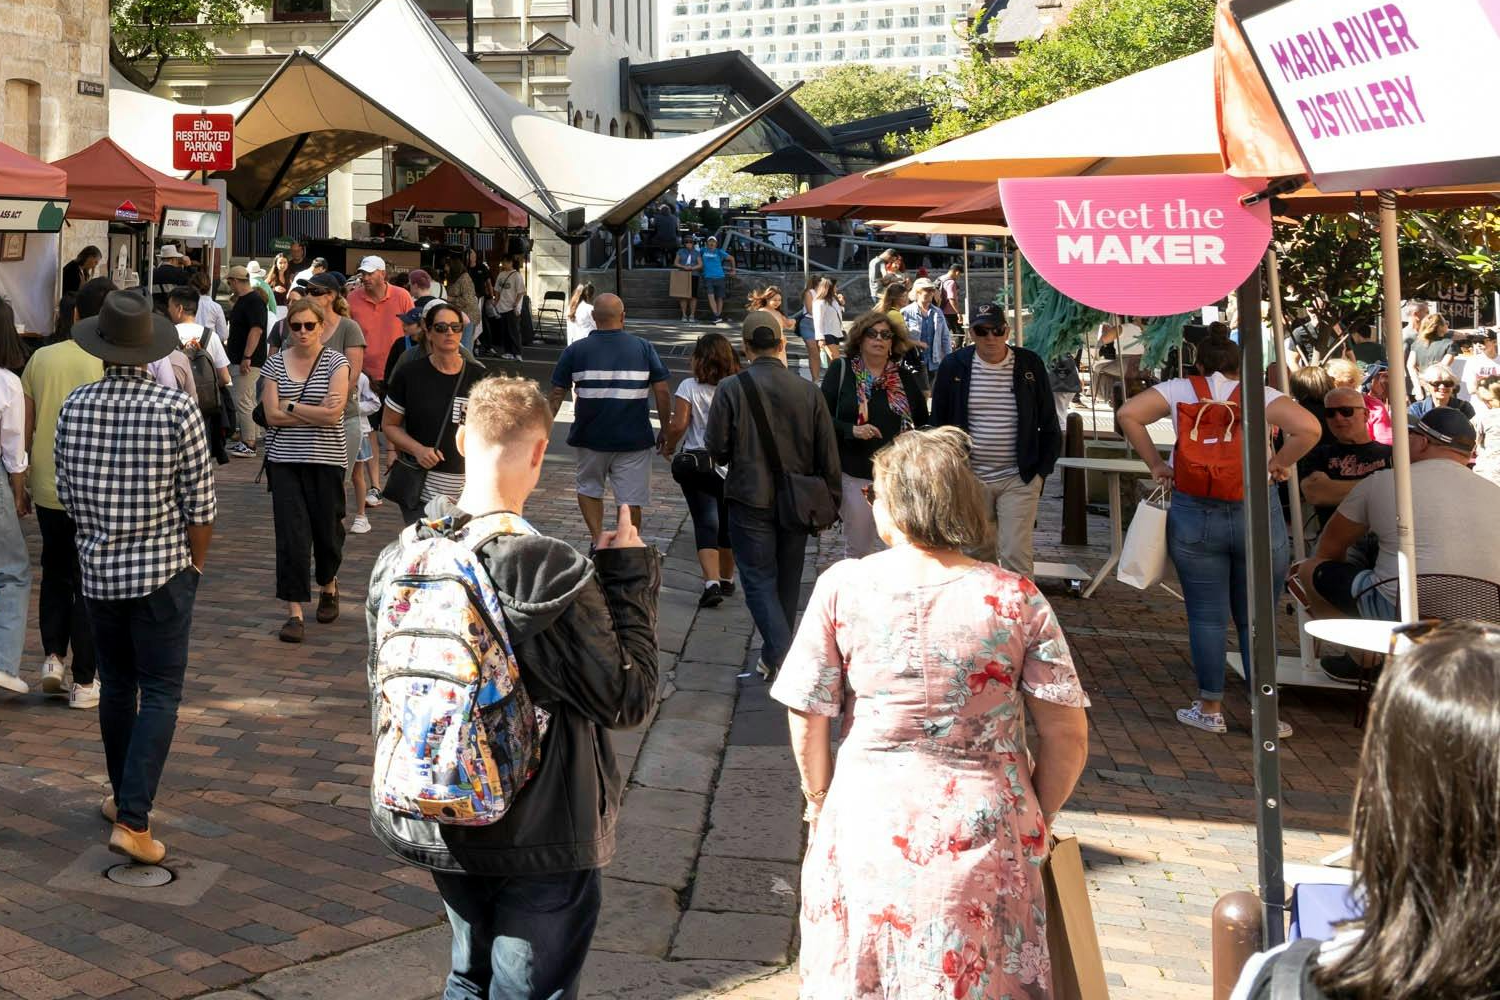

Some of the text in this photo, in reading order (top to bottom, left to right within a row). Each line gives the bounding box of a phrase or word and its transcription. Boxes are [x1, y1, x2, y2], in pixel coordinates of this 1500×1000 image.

[1270, 3, 1419, 83] MARIA RIVER
[1297, 75, 1425, 140] DISTILLERY
[193, 120, 213, 131] END
[175, 131, 231, 141] RESTRICTED
[184, 141, 223, 152] PARKING
[190, 151, 216, 163] AREA
[11, 210, 22, 219] ACT
[1054, 198, 1225, 230] Meet the
[1056, 235, 1226, 265] MAKER
